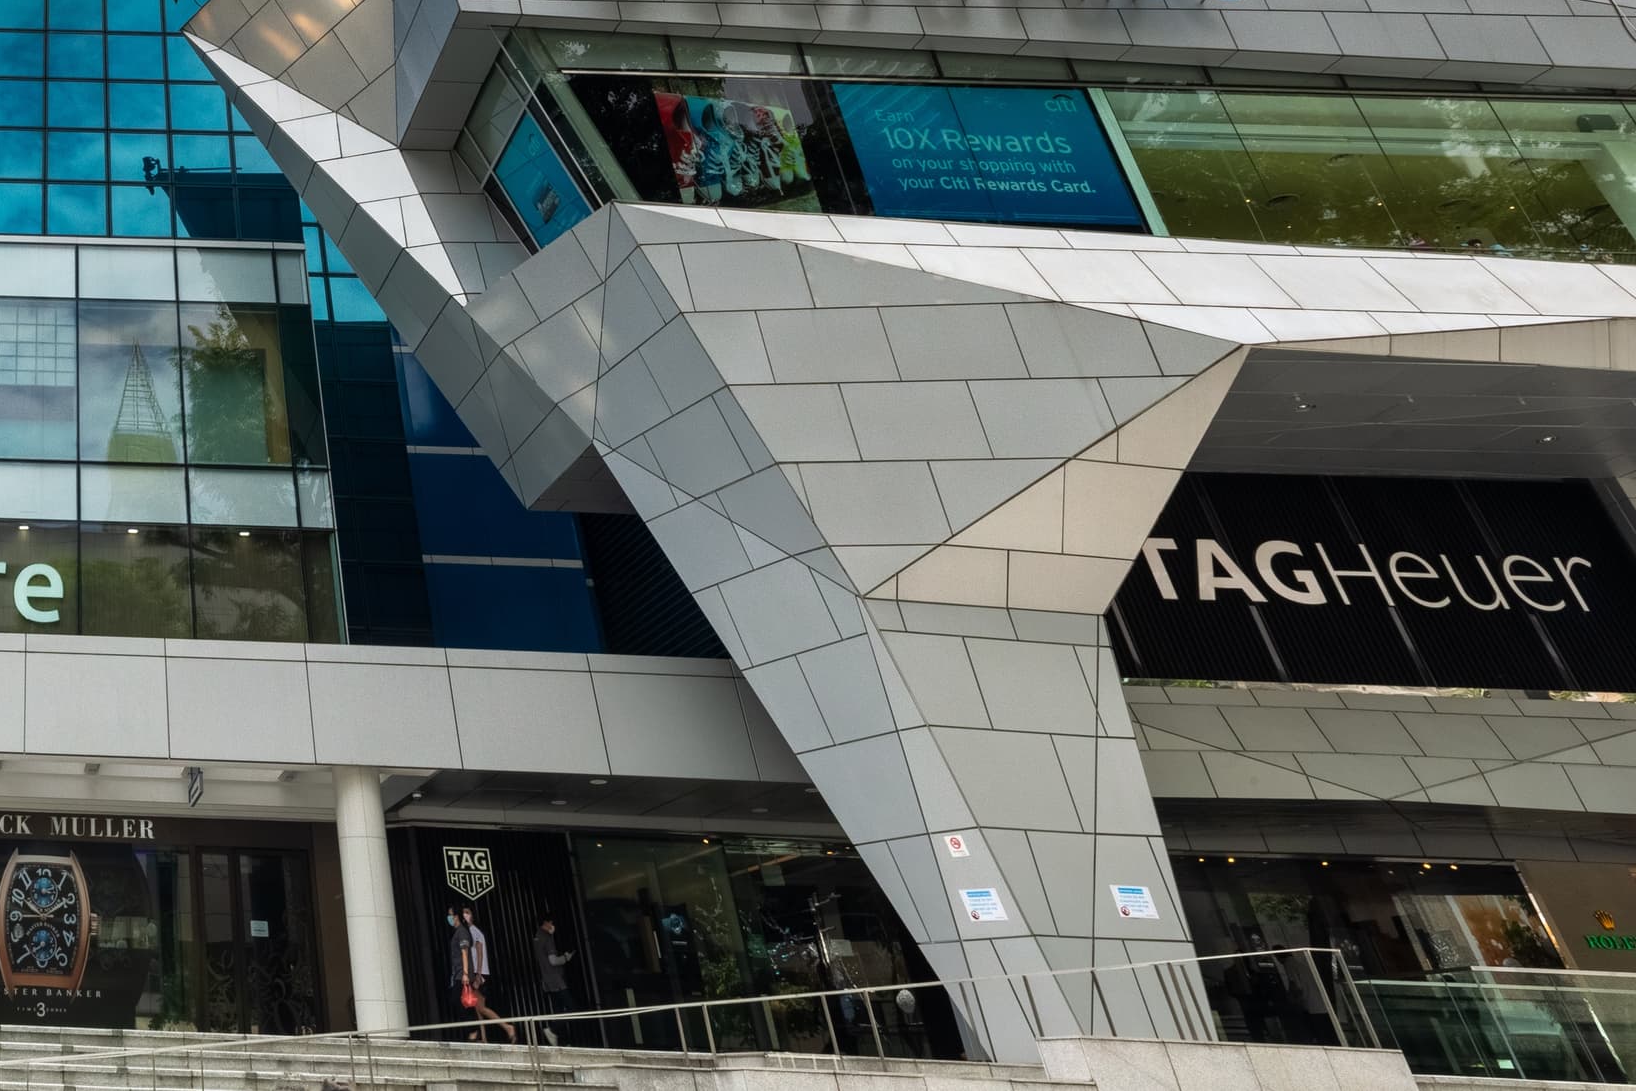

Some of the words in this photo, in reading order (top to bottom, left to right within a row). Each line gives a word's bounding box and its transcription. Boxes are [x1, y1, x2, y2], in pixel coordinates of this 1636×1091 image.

[875, 109, 914, 123] Earn
[881, 126, 937, 151] 10X
[941, 128, 1073, 154] Rewards
[892, 159, 913, 170] on
[918, 159, 954, 172] your
[960, 158, 1036, 175] shopping
[1039, 160, 1077, 173] with
[898, 177, 935, 191] your
[940, 176, 971, 190] Citi
[974, 177, 1047, 192] Rewards
[1050, 179, 1097, 193] Card.
[49, 816, 155, 840] MULLER
[447, 851, 487, 870] TAG
[450, 873, 491, 896] HEUER
[64, 913, 76, 924] 3
[46, 989, 101, 998] BANKER
[36, 1002, 46, 1017] 3
